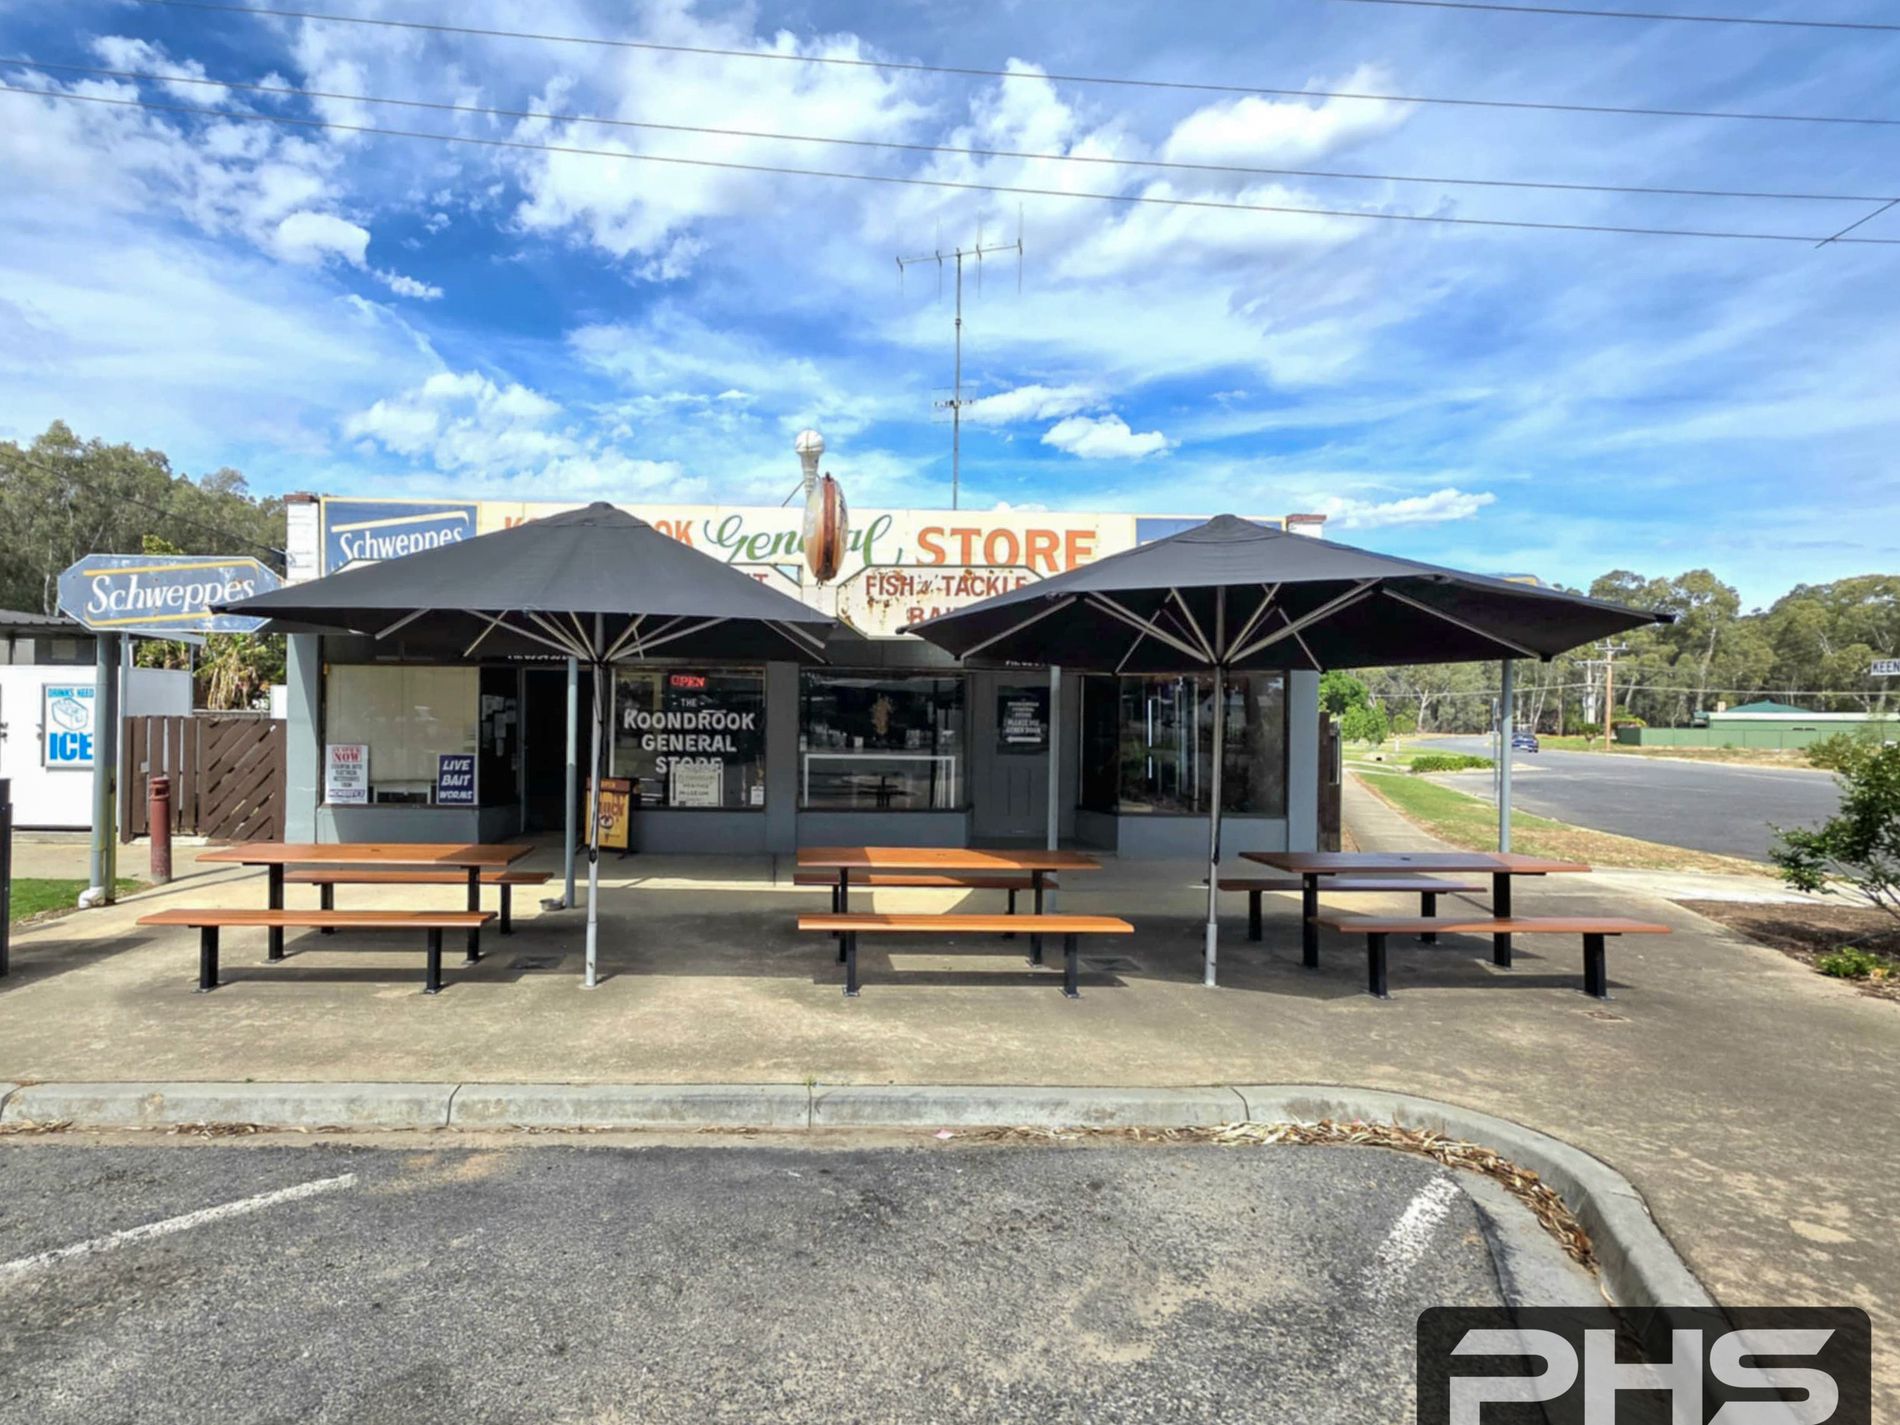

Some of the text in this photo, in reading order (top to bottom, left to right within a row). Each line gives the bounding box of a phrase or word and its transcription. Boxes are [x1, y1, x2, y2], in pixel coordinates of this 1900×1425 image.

[916, 526, 1096, 573] STORE
[87, 573, 256, 614] Schweppes
[865, 575, 915, 596] FISH
[670, 674, 705, 688] OPEN
[680, 698, 699, 708] THE
[623, 708, 756, 731] KOONDROOK
[49, 732, 93, 760] ICE
[641, 733, 737, 752] GENERAL
[442, 760, 471, 770] LIVE
[441, 775, 471, 786] BAIT
